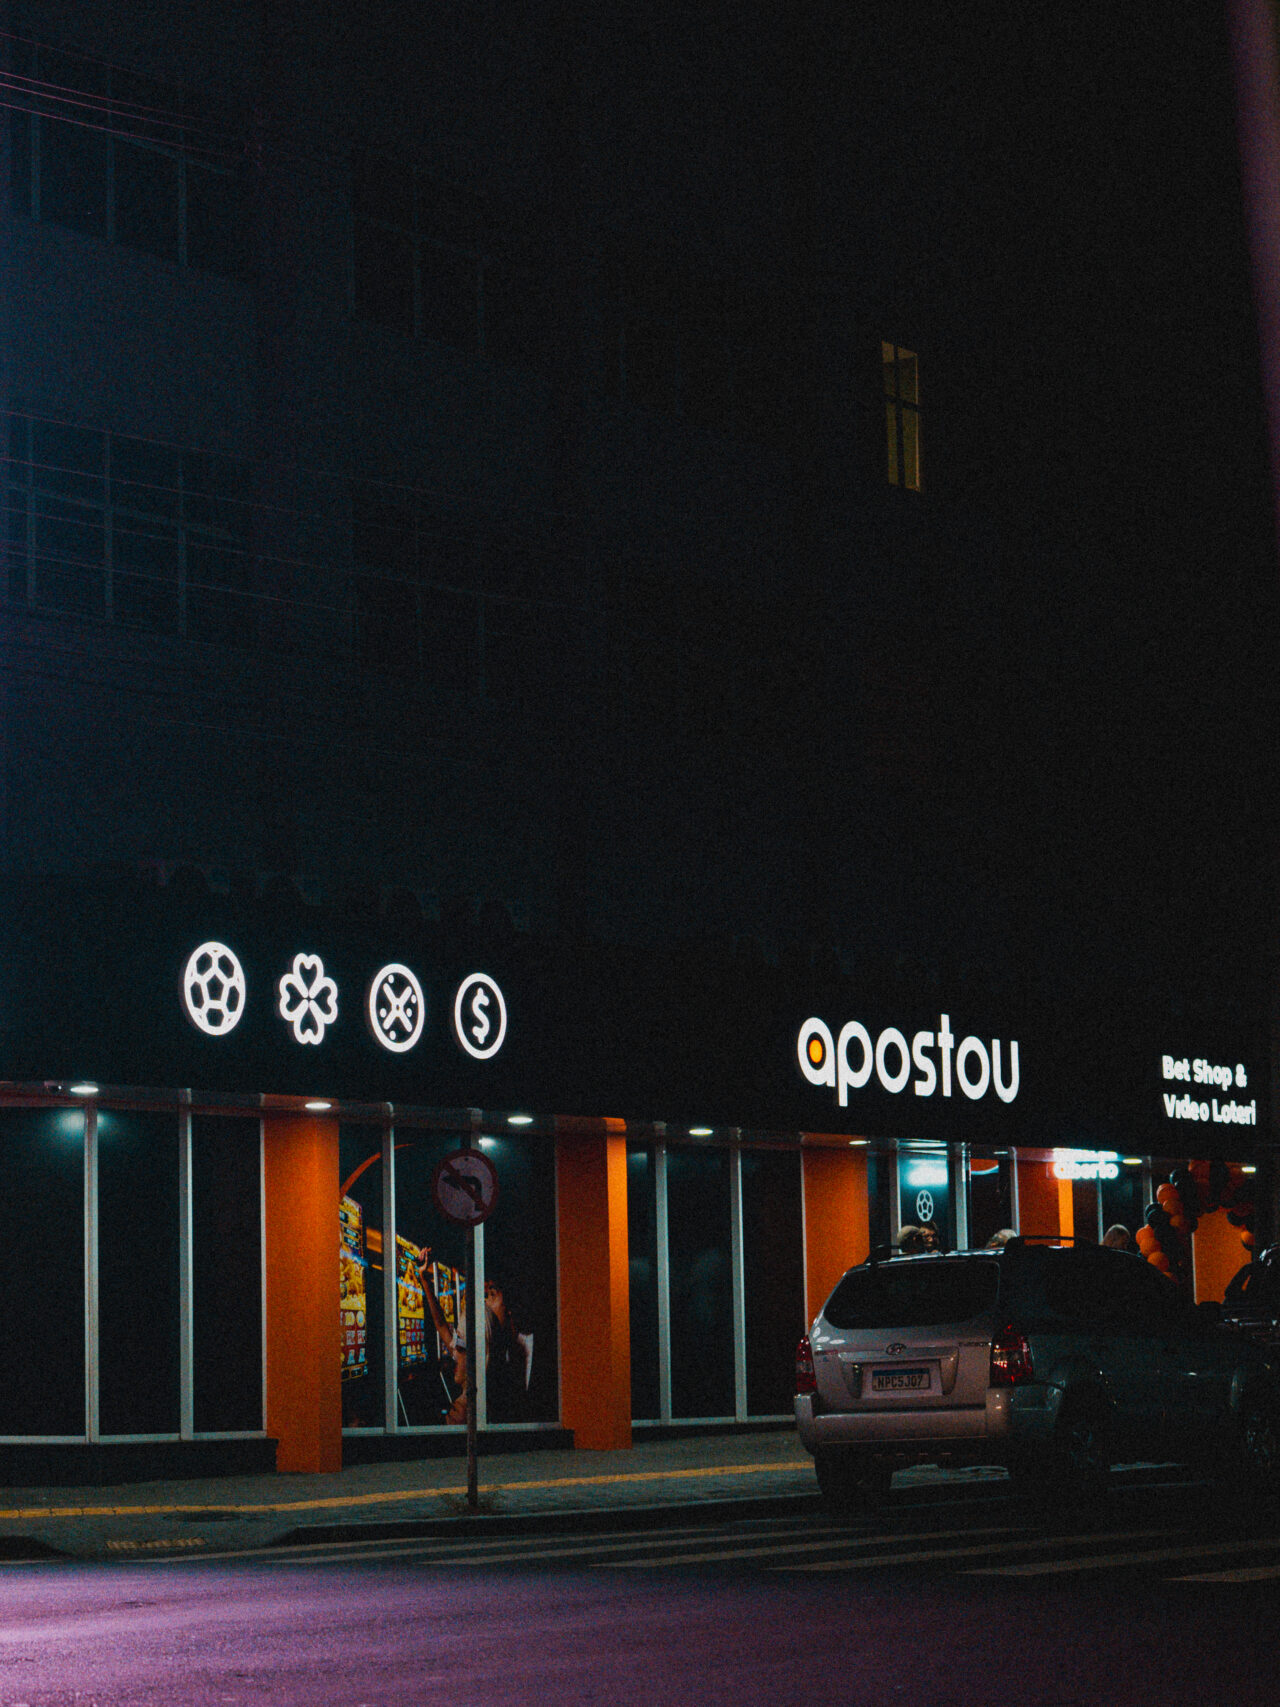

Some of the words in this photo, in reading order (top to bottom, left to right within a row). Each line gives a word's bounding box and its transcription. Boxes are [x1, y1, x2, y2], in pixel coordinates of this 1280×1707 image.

[797, 1013, 1019, 1107] apostou
[1162, 1055, 1191, 1081] Bet
[1192, 1058, 1232, 1091] Shop
[1235, 1063, 1248, 1088] &
